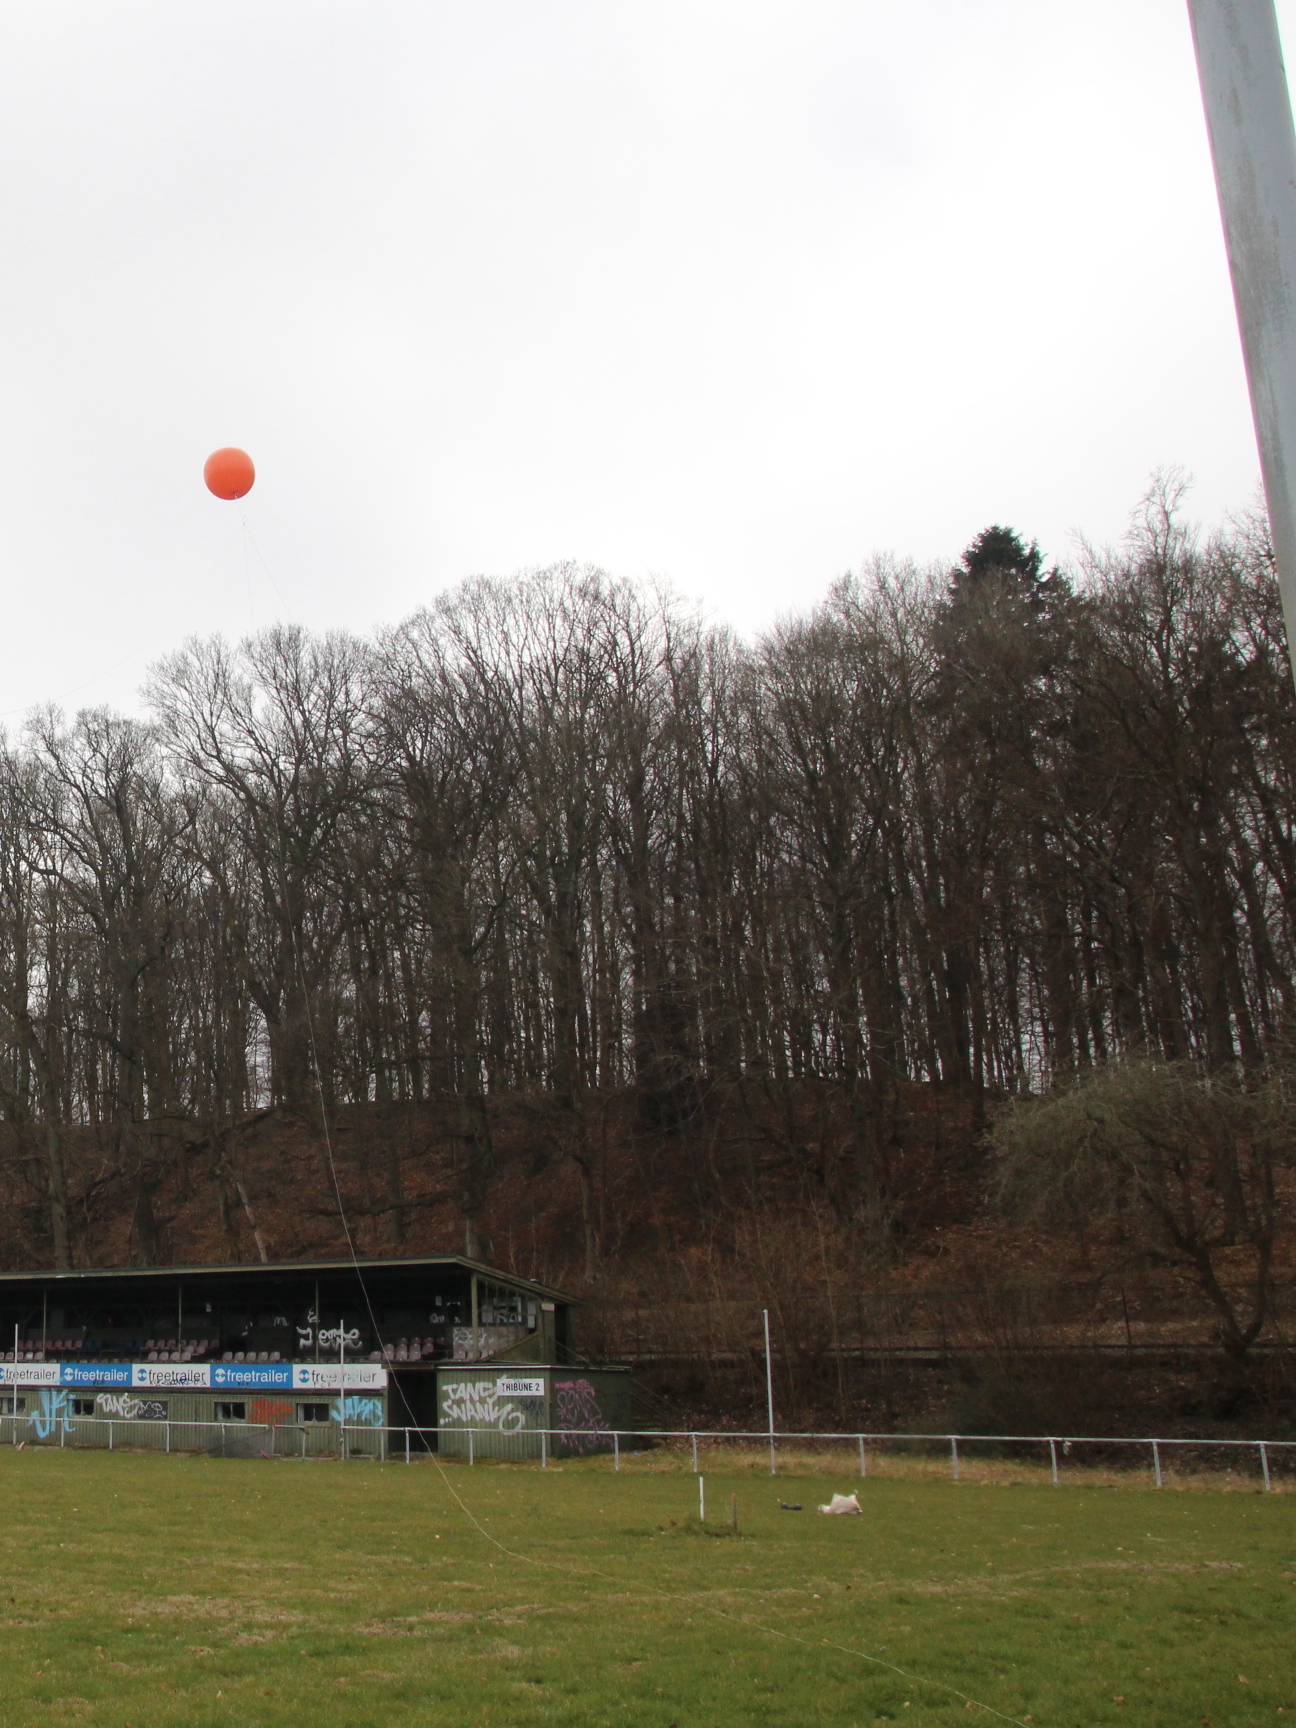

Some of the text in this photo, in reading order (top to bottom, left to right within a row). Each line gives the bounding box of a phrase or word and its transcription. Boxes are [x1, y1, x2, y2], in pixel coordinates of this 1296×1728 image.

[74, 1368, 128, 1381] freetrailer
[148, 1369, 206, 1381] freetrailer
[227, 1370, 289, 1383] freetrailer
[501, 1382, 540, 1392] TRIBUNE 2
